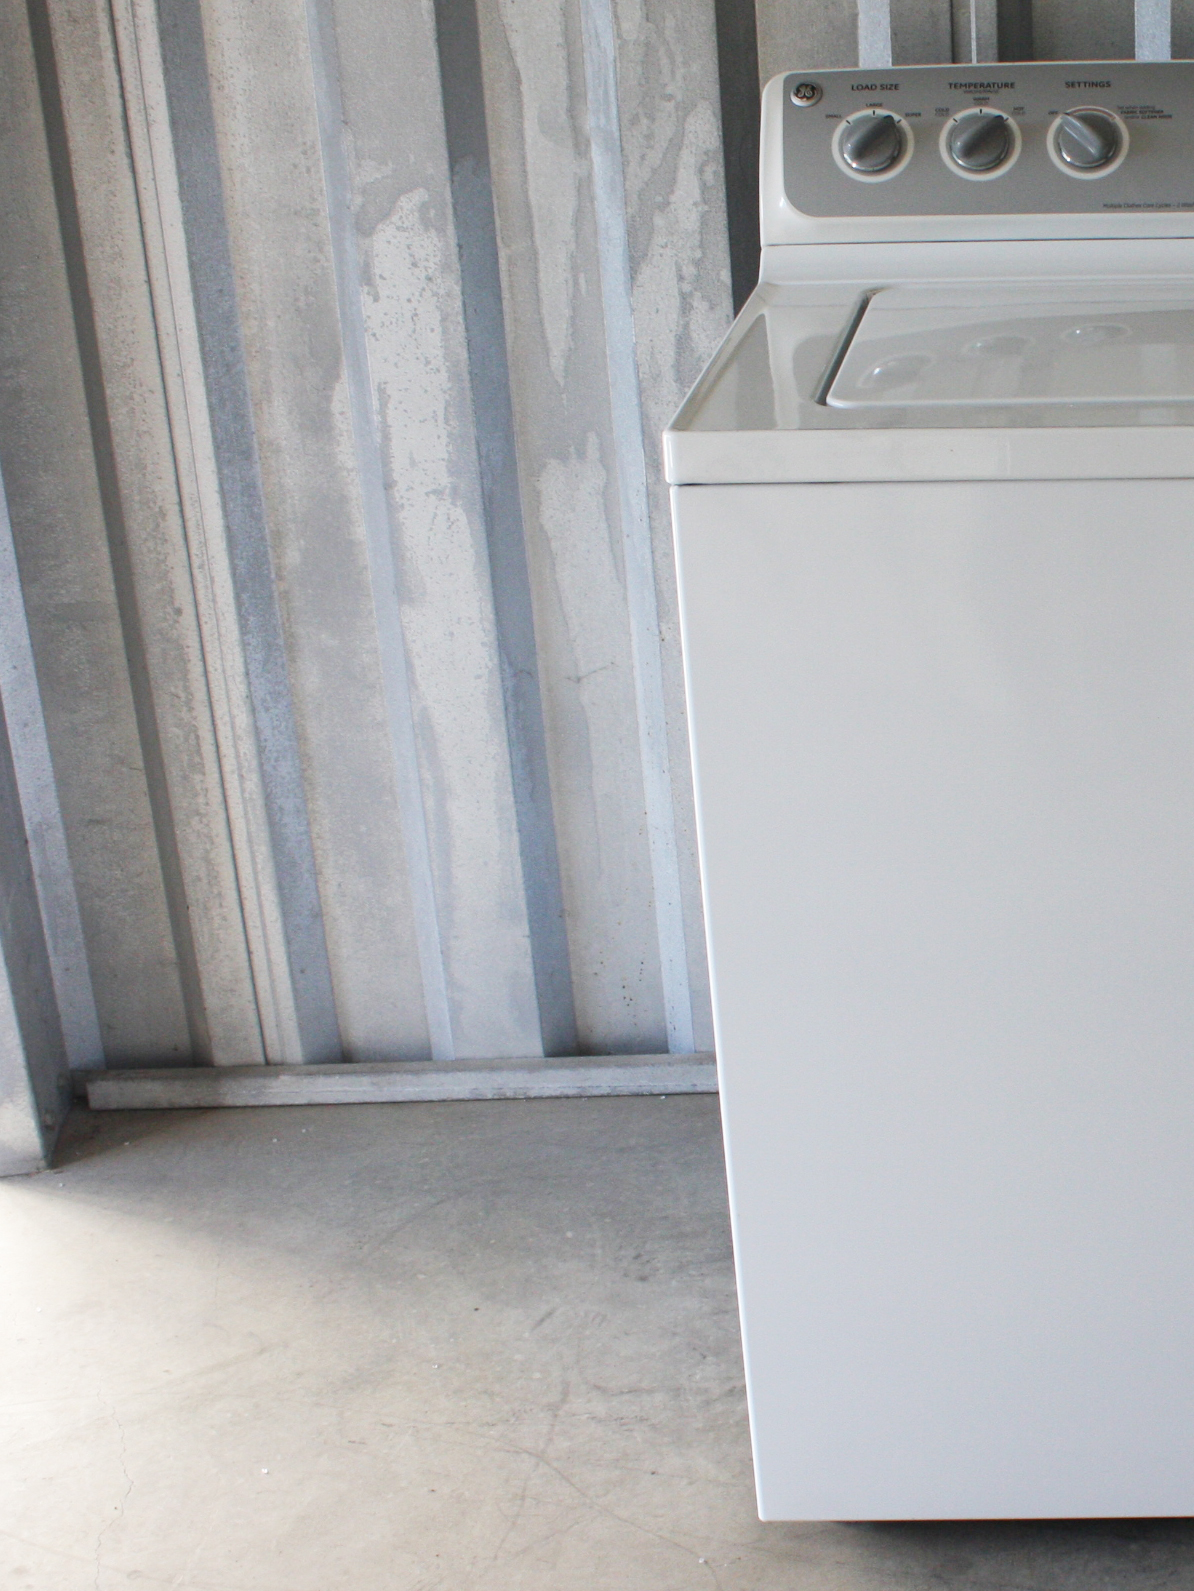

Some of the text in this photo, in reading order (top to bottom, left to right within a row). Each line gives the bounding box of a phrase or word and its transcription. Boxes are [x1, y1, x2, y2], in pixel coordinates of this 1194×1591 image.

[851, 83, 900, 91] LOAD SIZE
[948, 82, 1015, 90] TEMPERATURE
[1065, 81, 1111, 89] SETTINGS
